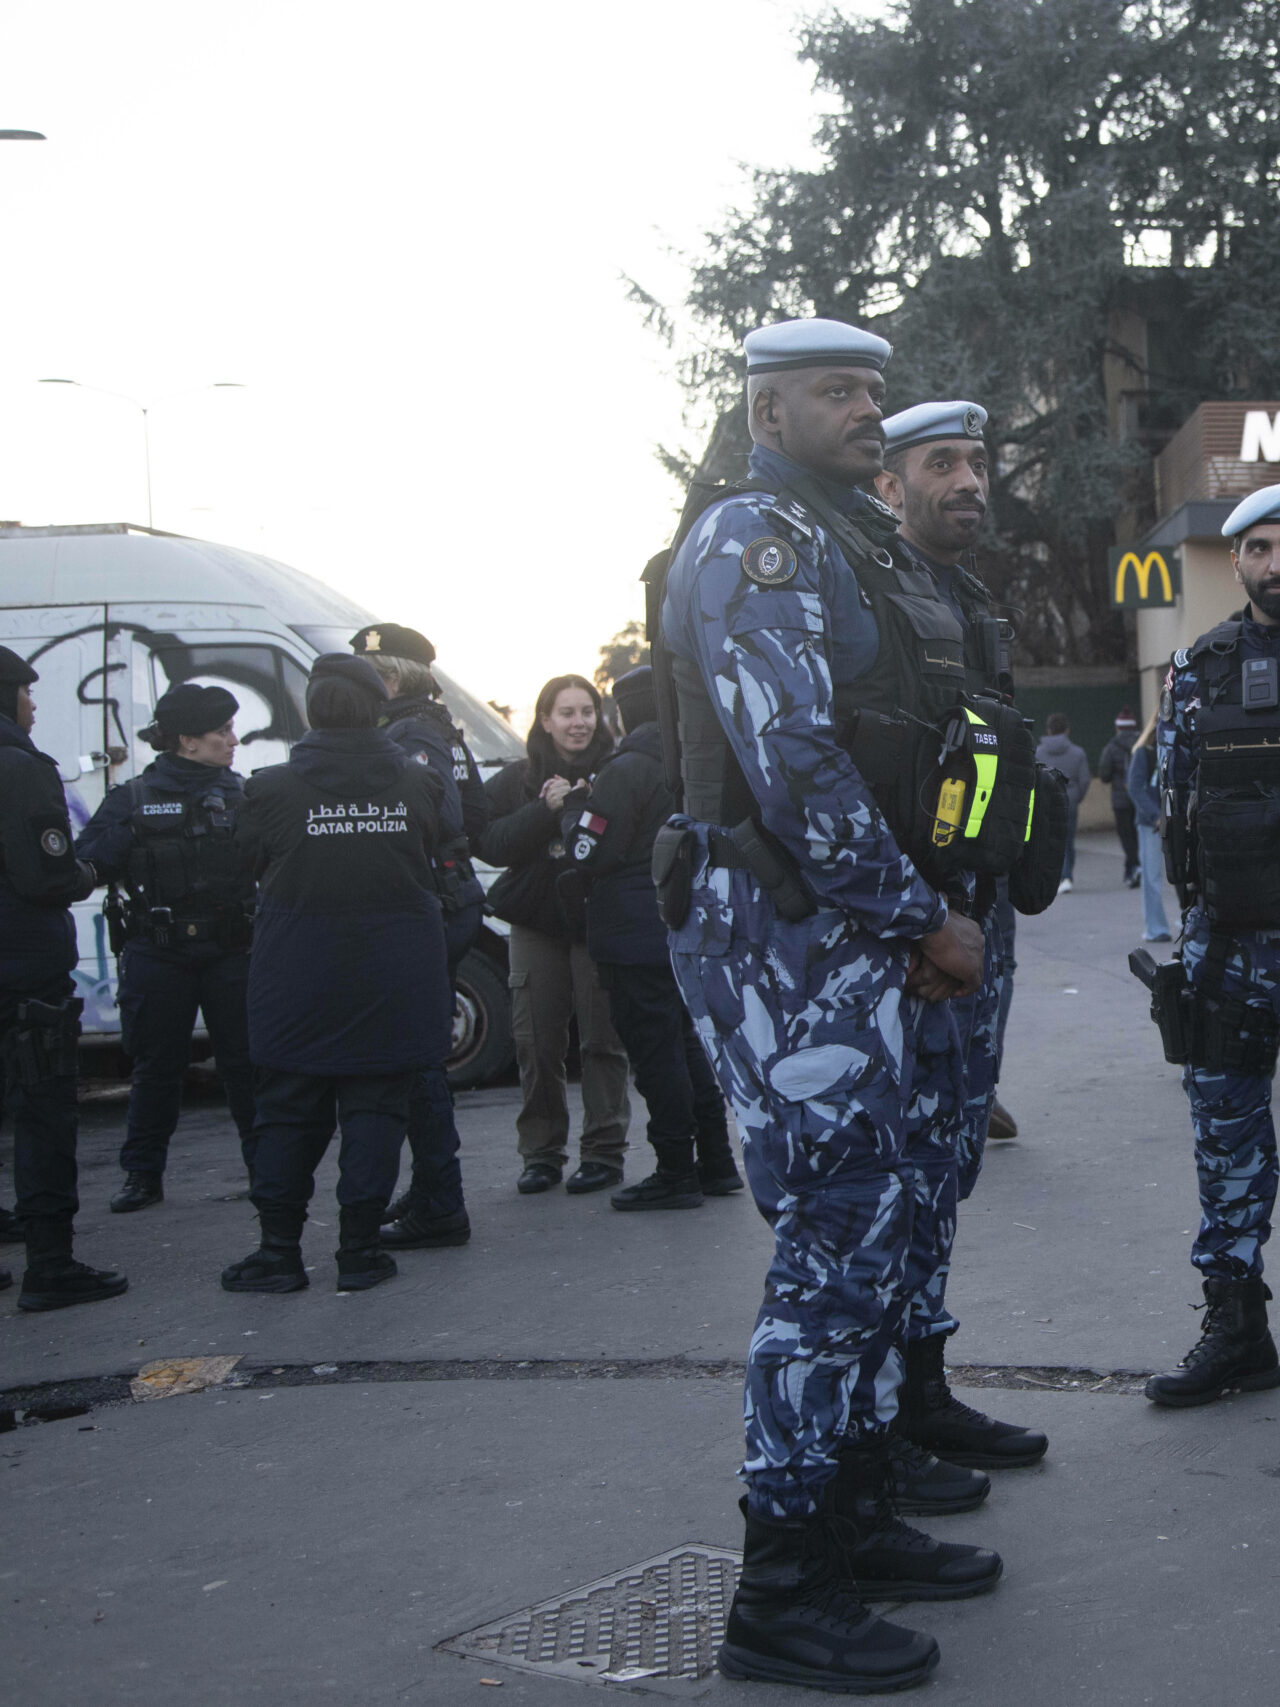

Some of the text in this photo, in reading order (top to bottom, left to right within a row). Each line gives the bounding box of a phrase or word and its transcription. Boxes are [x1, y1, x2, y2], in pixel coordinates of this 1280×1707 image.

[973, 732, 998, 746] TASER
[143, 807, 183, 815] LOCALE
[306, 801, 408, 823] شرطة قطر
[307, 821, 408, 836] QATAR POLIZIA
